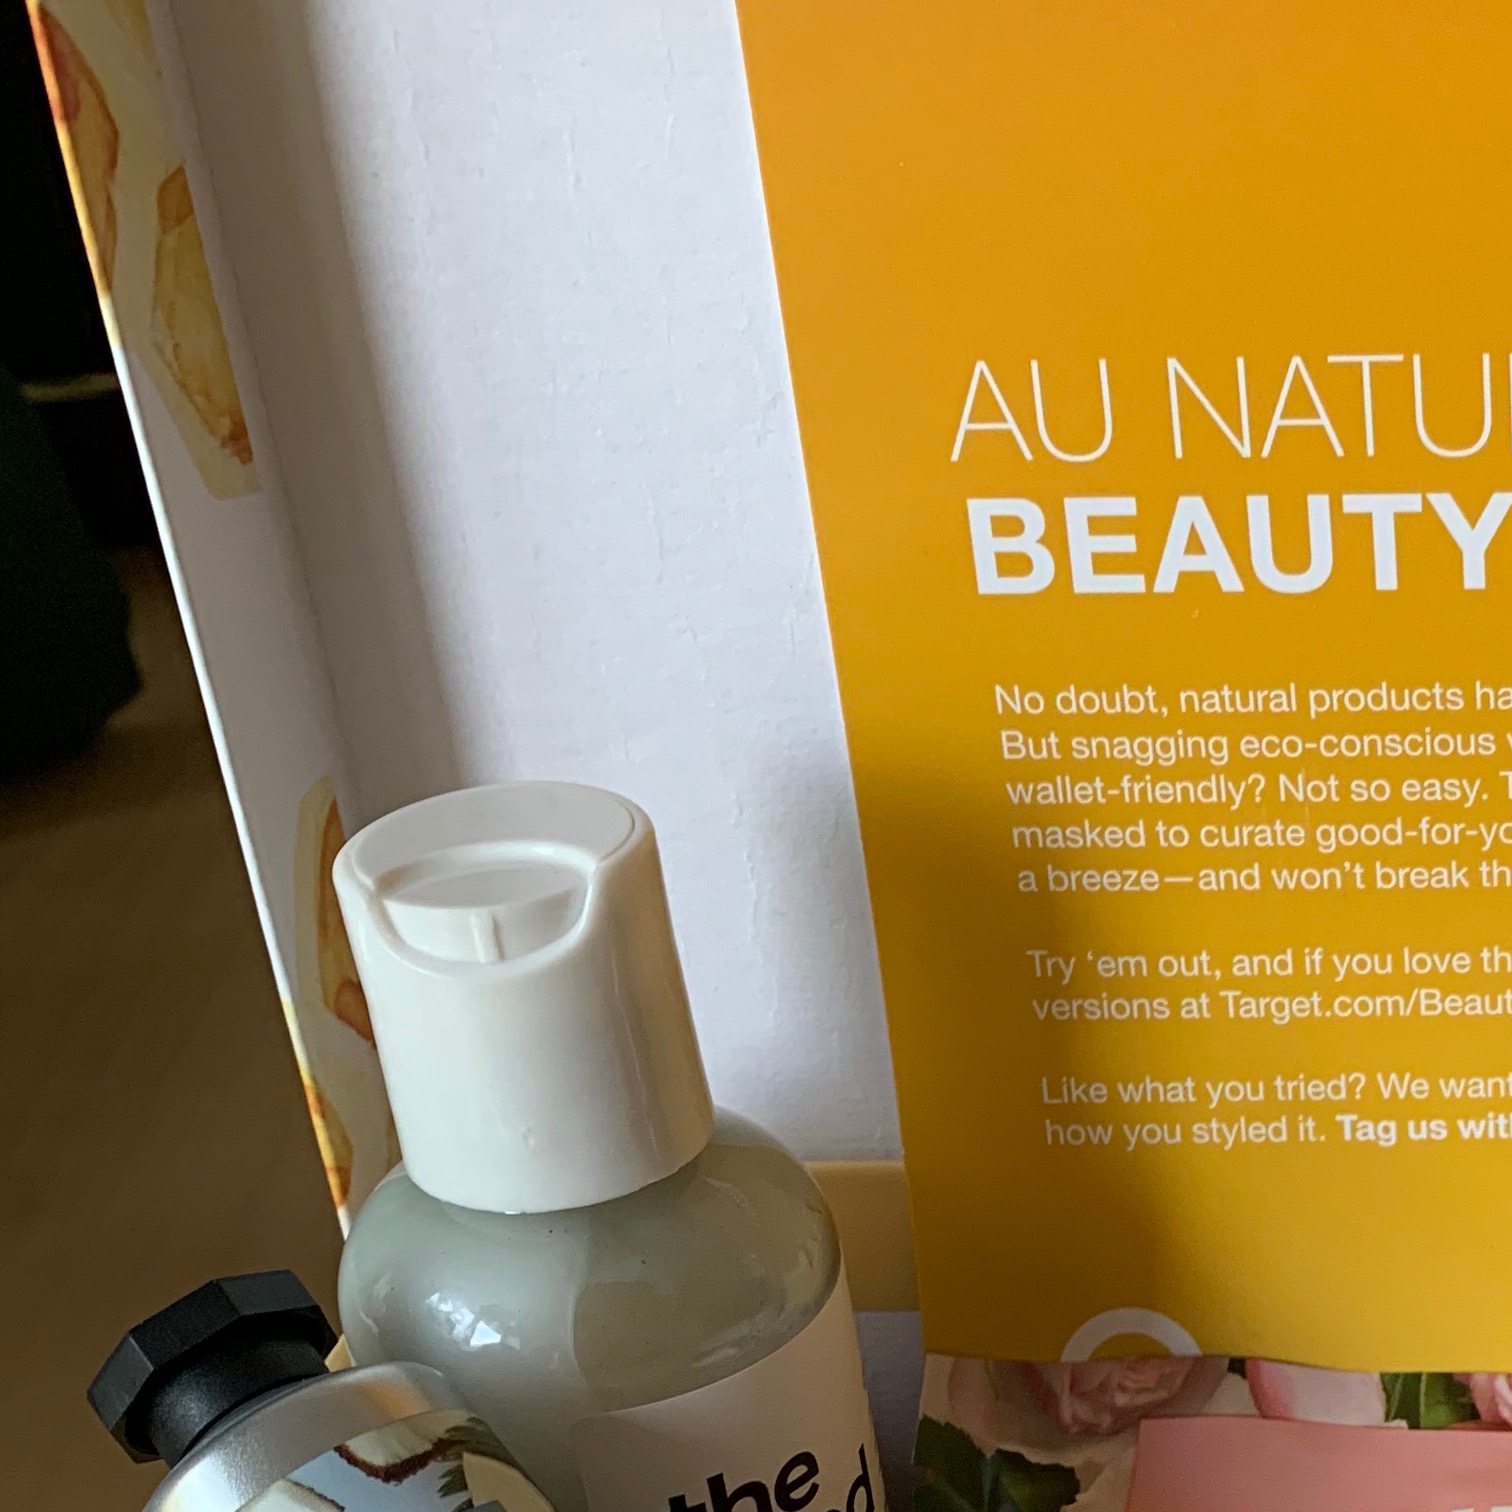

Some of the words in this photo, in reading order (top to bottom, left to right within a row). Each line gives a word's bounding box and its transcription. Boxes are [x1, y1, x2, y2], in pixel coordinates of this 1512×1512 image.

[950, 359, 1113, 463] AU
[994, 684, 1045, 715] No
[1055, 683, 1168, 717] doubt,
[1179, 682, 1297, 713] natural
[1308, 680, 1465, 719] products
[1000, 729, 1061, 760] But
[1071, 729, 1229, 766] snagging
[1240, 727, 1496, 758] eco-conscious
[1005, 772, 1266, 810] wallet-friendly?
[1279, 773, 1340, 802] Not
[1350, 778, 1392, 802] so
[1401, 778, 1488, 808] easy.
[1019, 870, 1038, 892] a
[1271, 861, 1365, 891] won't
[1375, 860, 1470, 889] break
[1033, 993, 1171, 1020] versions
[1180, 992, 1211, 1020] at
[1046, 1120, 1112, 1145] how
[1123, 1124, 1182, 1152] you
[1192, 1116, 1288, 1151] styled
[1298, 1115, 1325, 1142] it.
[1336, 1113, 1398, 1148] Tag
[1407, 1119, 1448, 1141] us
